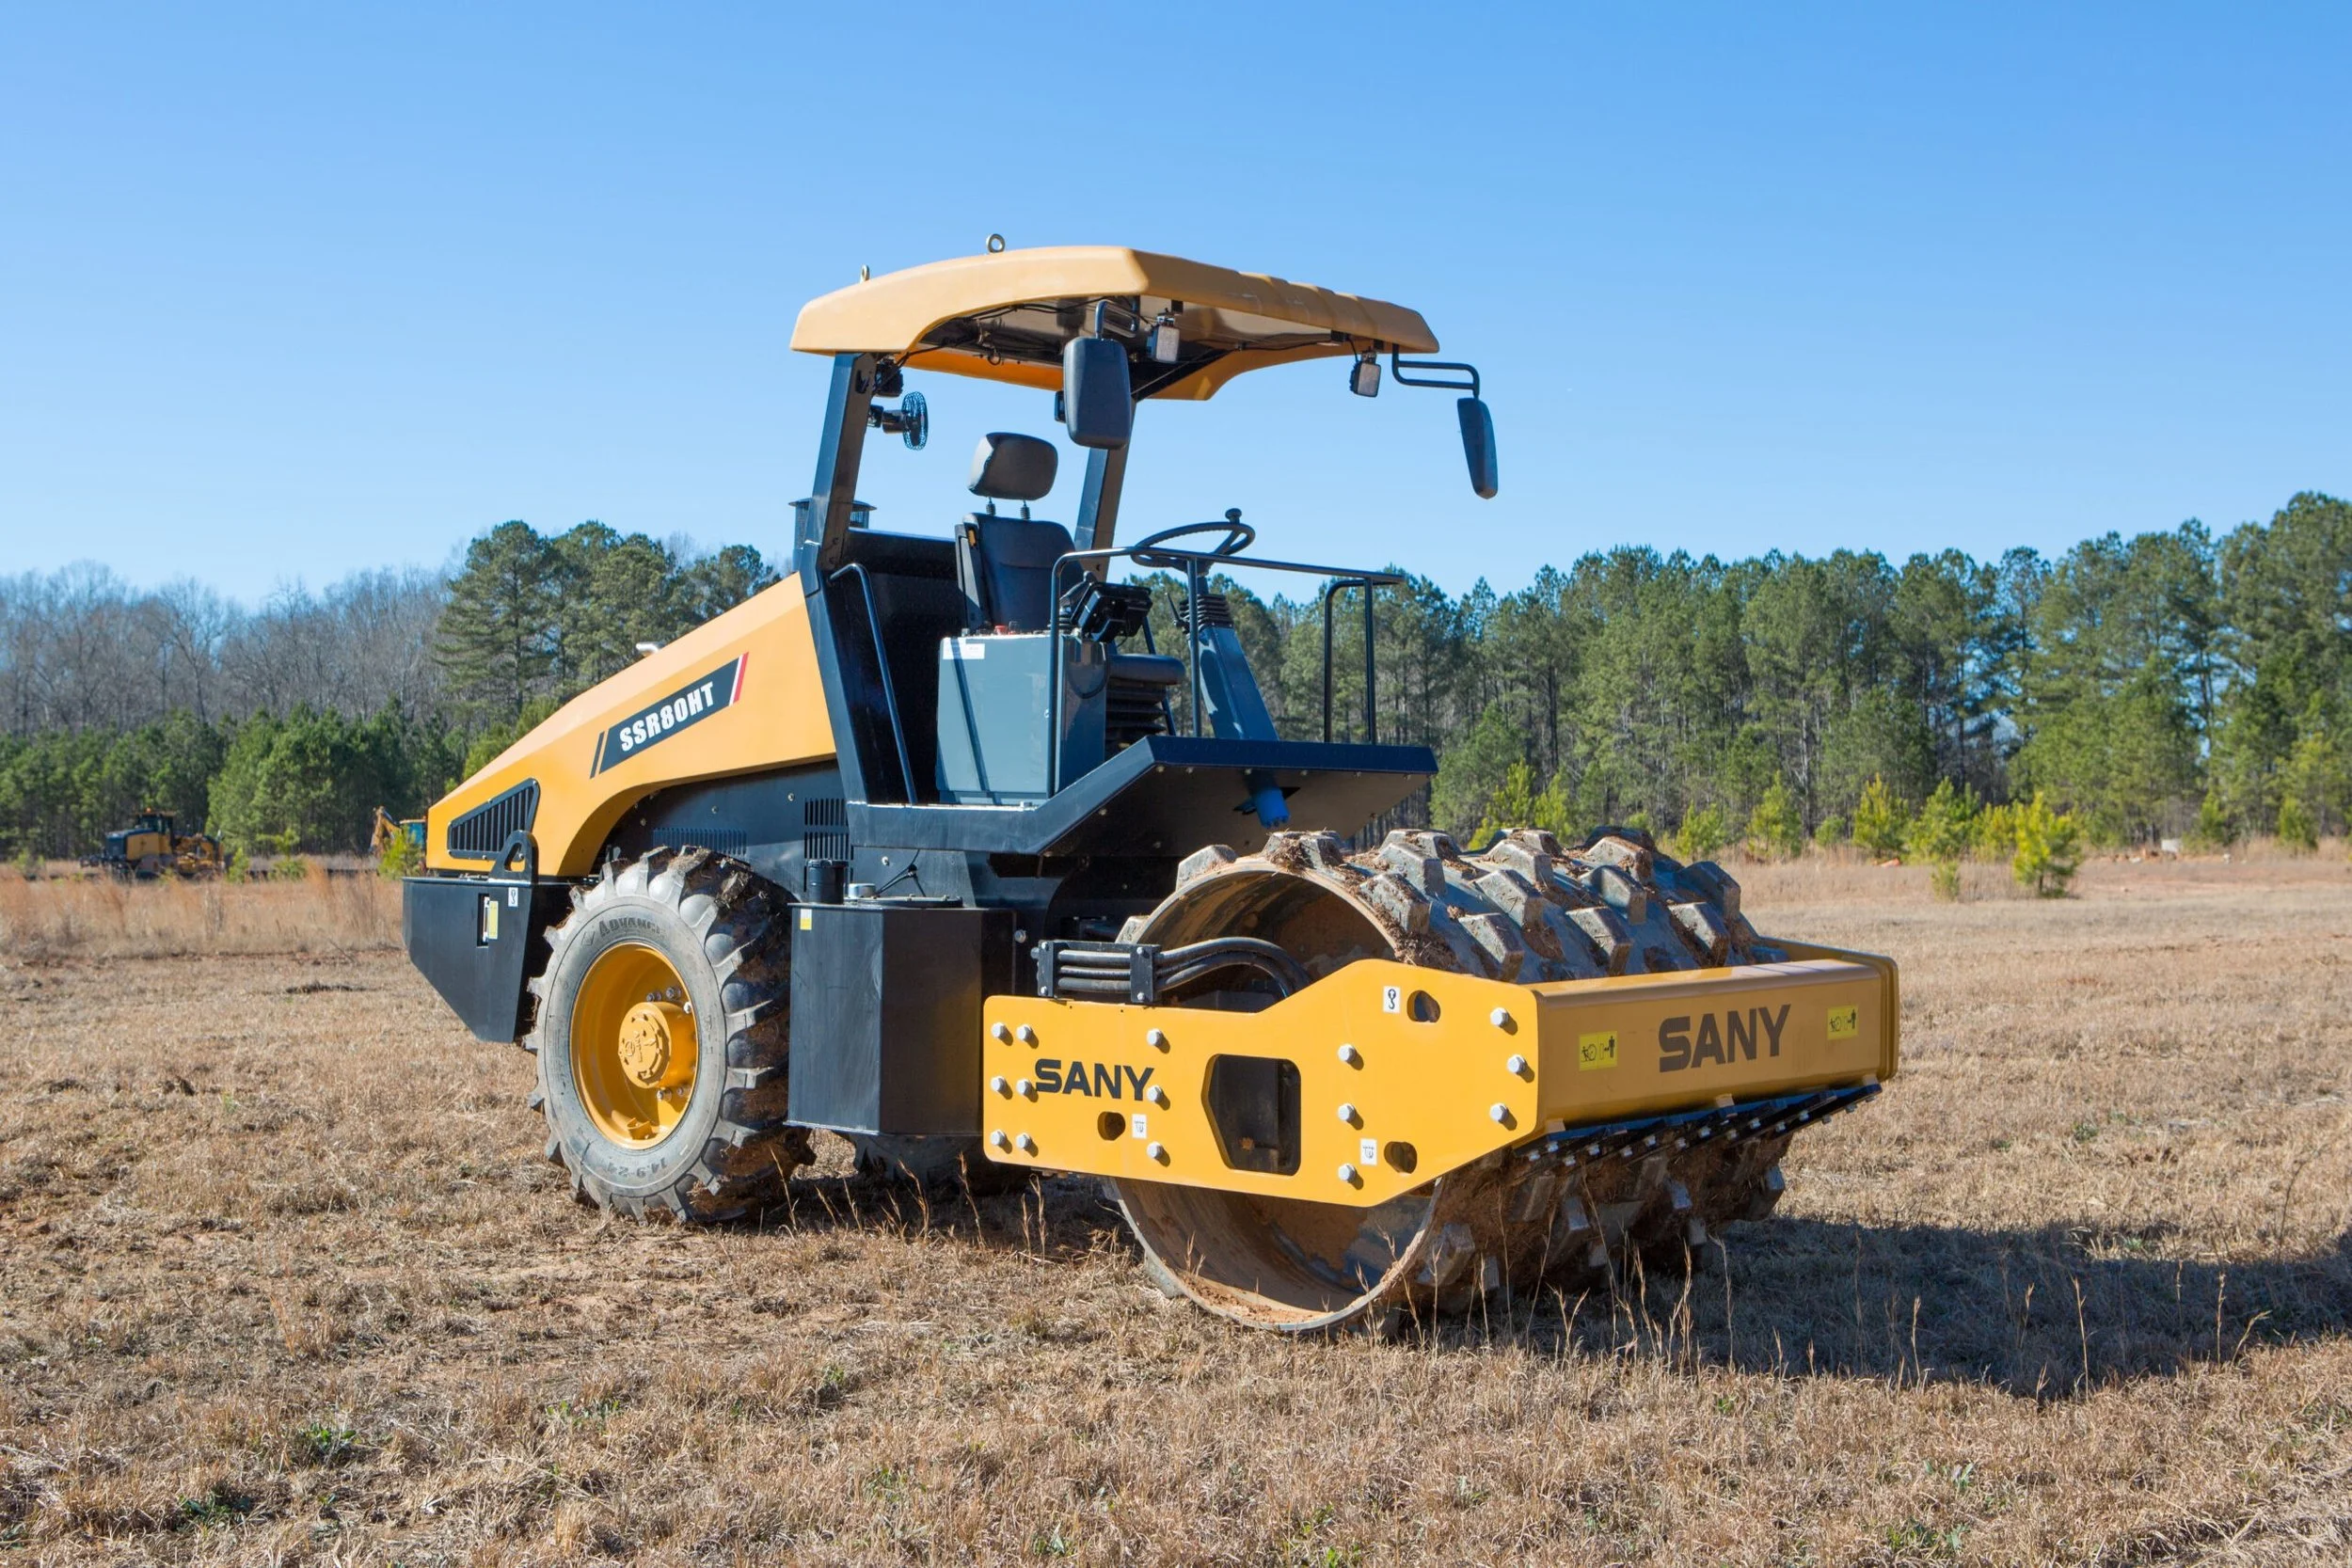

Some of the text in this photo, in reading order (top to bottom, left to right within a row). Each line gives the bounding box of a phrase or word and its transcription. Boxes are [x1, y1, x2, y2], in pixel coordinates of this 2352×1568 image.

[619, 681, 714, 752] SSR80HT
[1659, 1004, 1791, 1073] SANY
[1035, 1058, 1154, 1101] SANY
